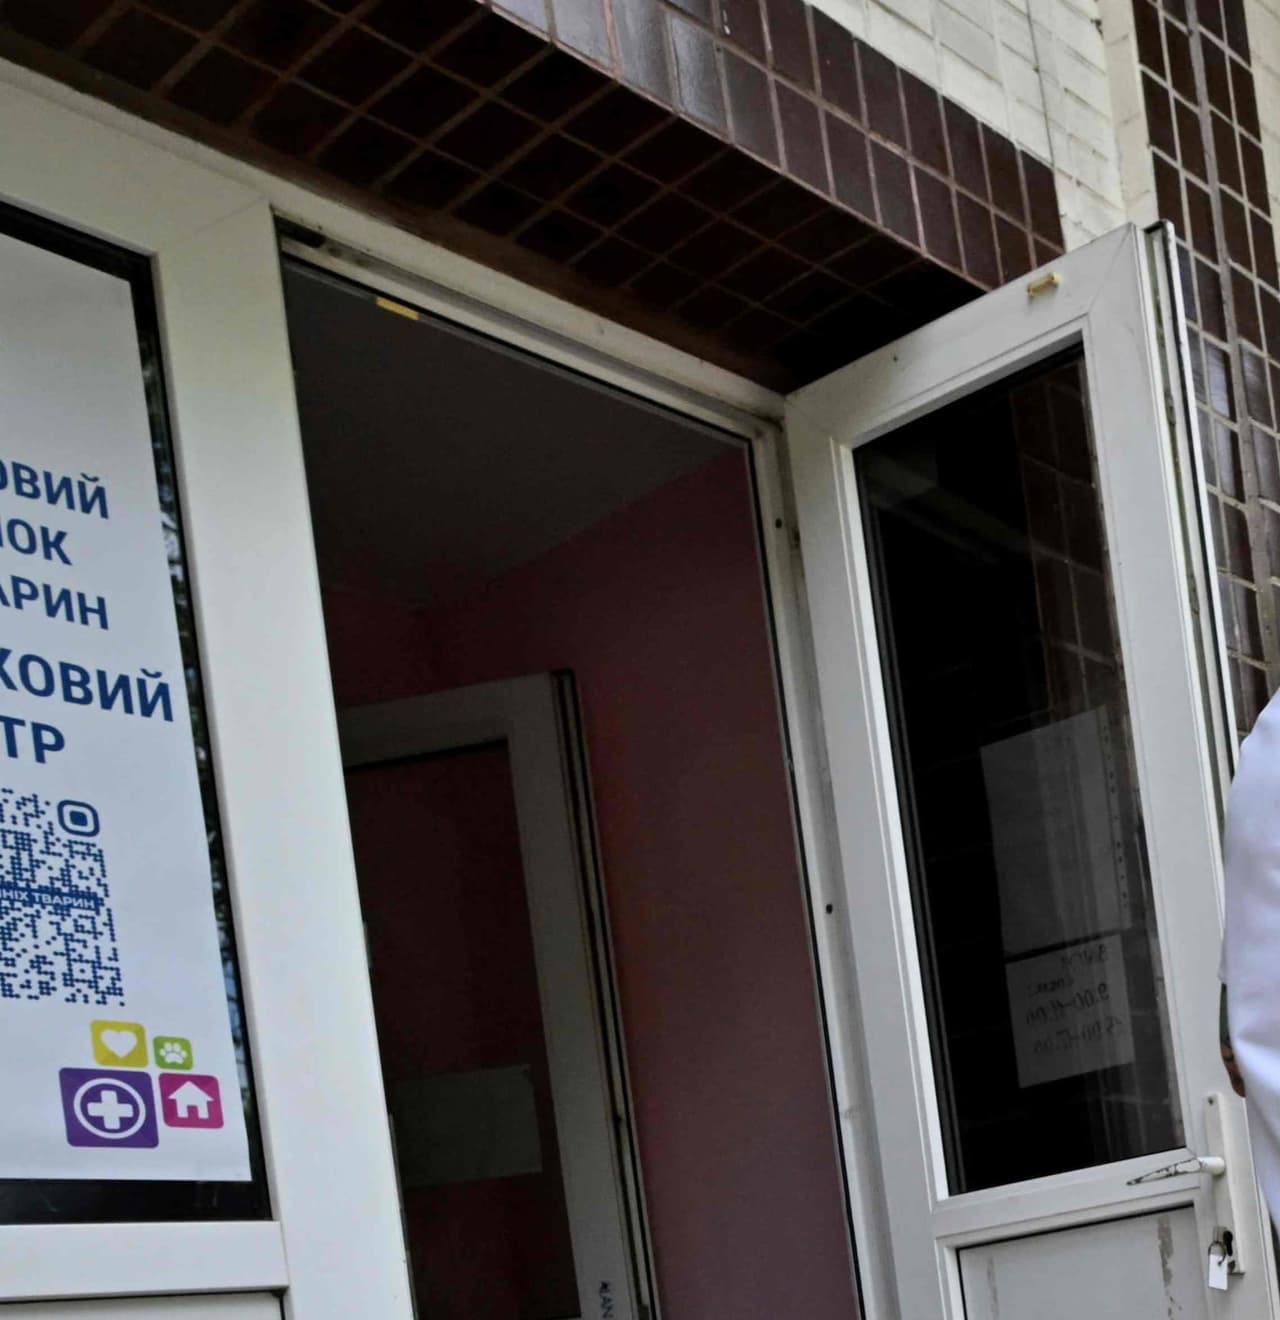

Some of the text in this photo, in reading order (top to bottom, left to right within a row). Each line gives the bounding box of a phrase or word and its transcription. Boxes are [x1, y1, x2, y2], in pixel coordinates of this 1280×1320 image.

[0, 517, 73, 566] ОК
[0, 888, 96, 909] НІХ ТВАРИН
